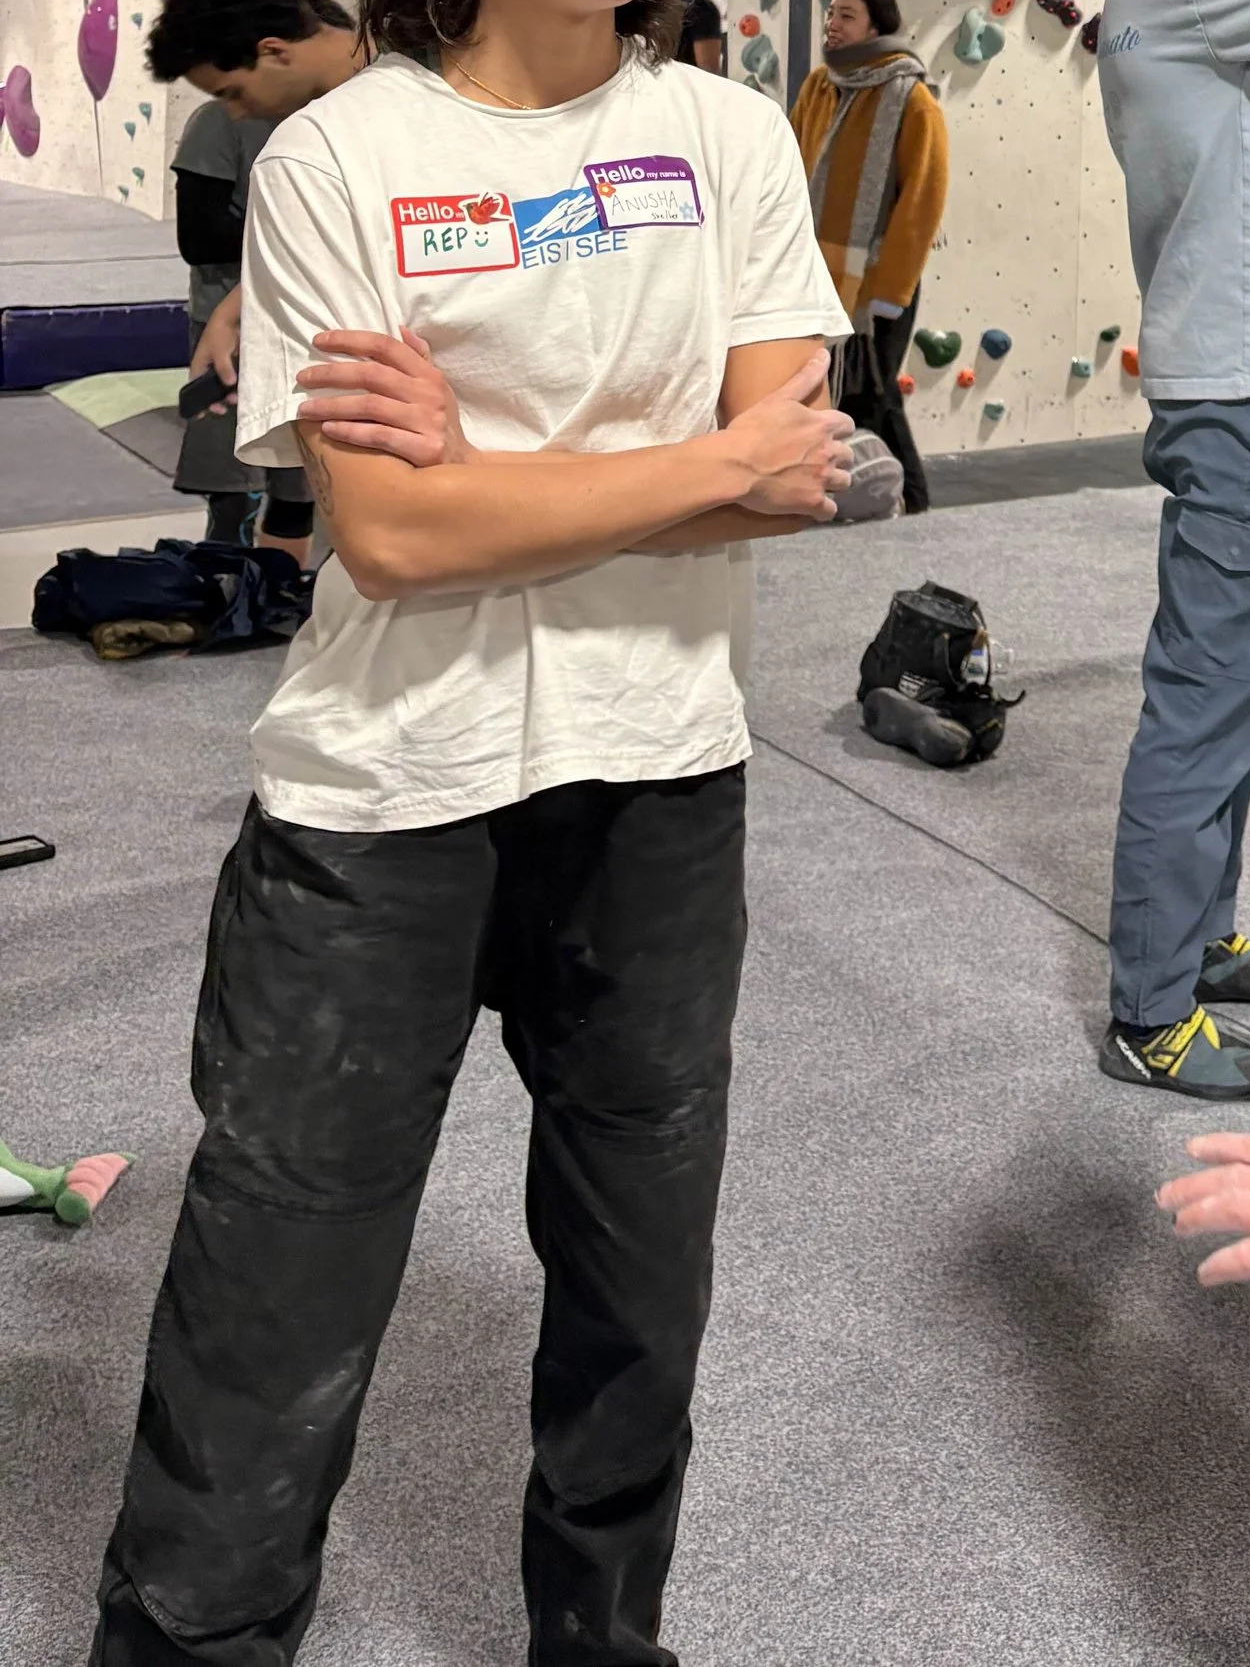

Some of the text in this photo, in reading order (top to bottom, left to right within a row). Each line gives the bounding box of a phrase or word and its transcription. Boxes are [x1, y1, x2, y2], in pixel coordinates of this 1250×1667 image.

[590, 165, 645, 184] Hello
[398, 202, 454, 222] Hello
[611, 190, 678, 216] ANUSHA
[423, 227, 468, 256] REP
